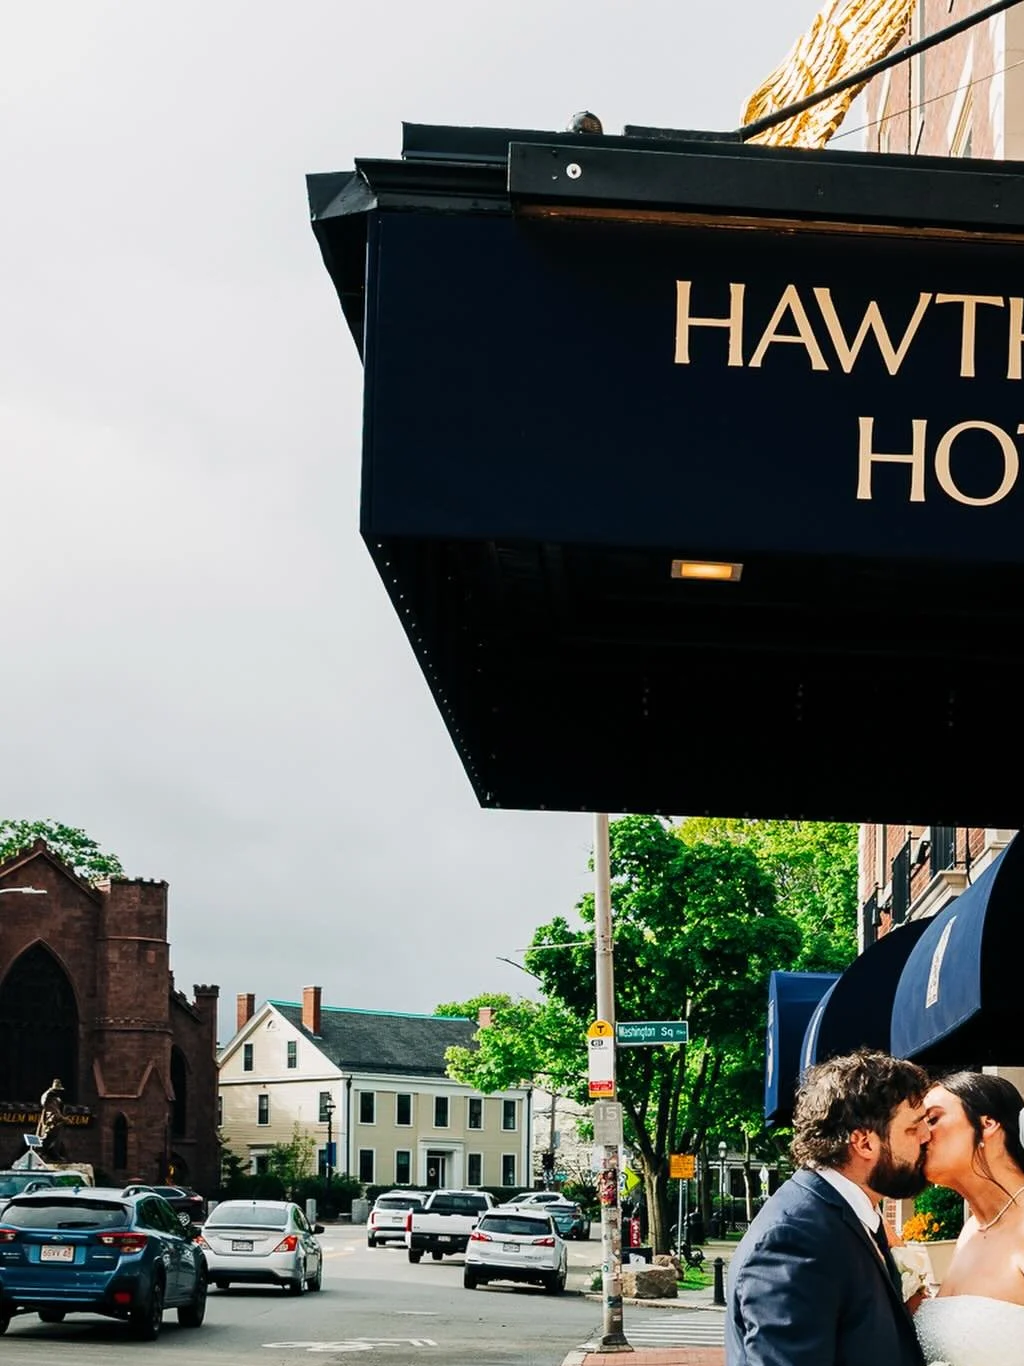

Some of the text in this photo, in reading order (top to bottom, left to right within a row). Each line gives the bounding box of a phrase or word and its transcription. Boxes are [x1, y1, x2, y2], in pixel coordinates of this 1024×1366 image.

[596, 1025, 605, 1034] T
[618, 1025, 673, 1040] Washington Sq
[599, 1107, 617, 1120] 15
